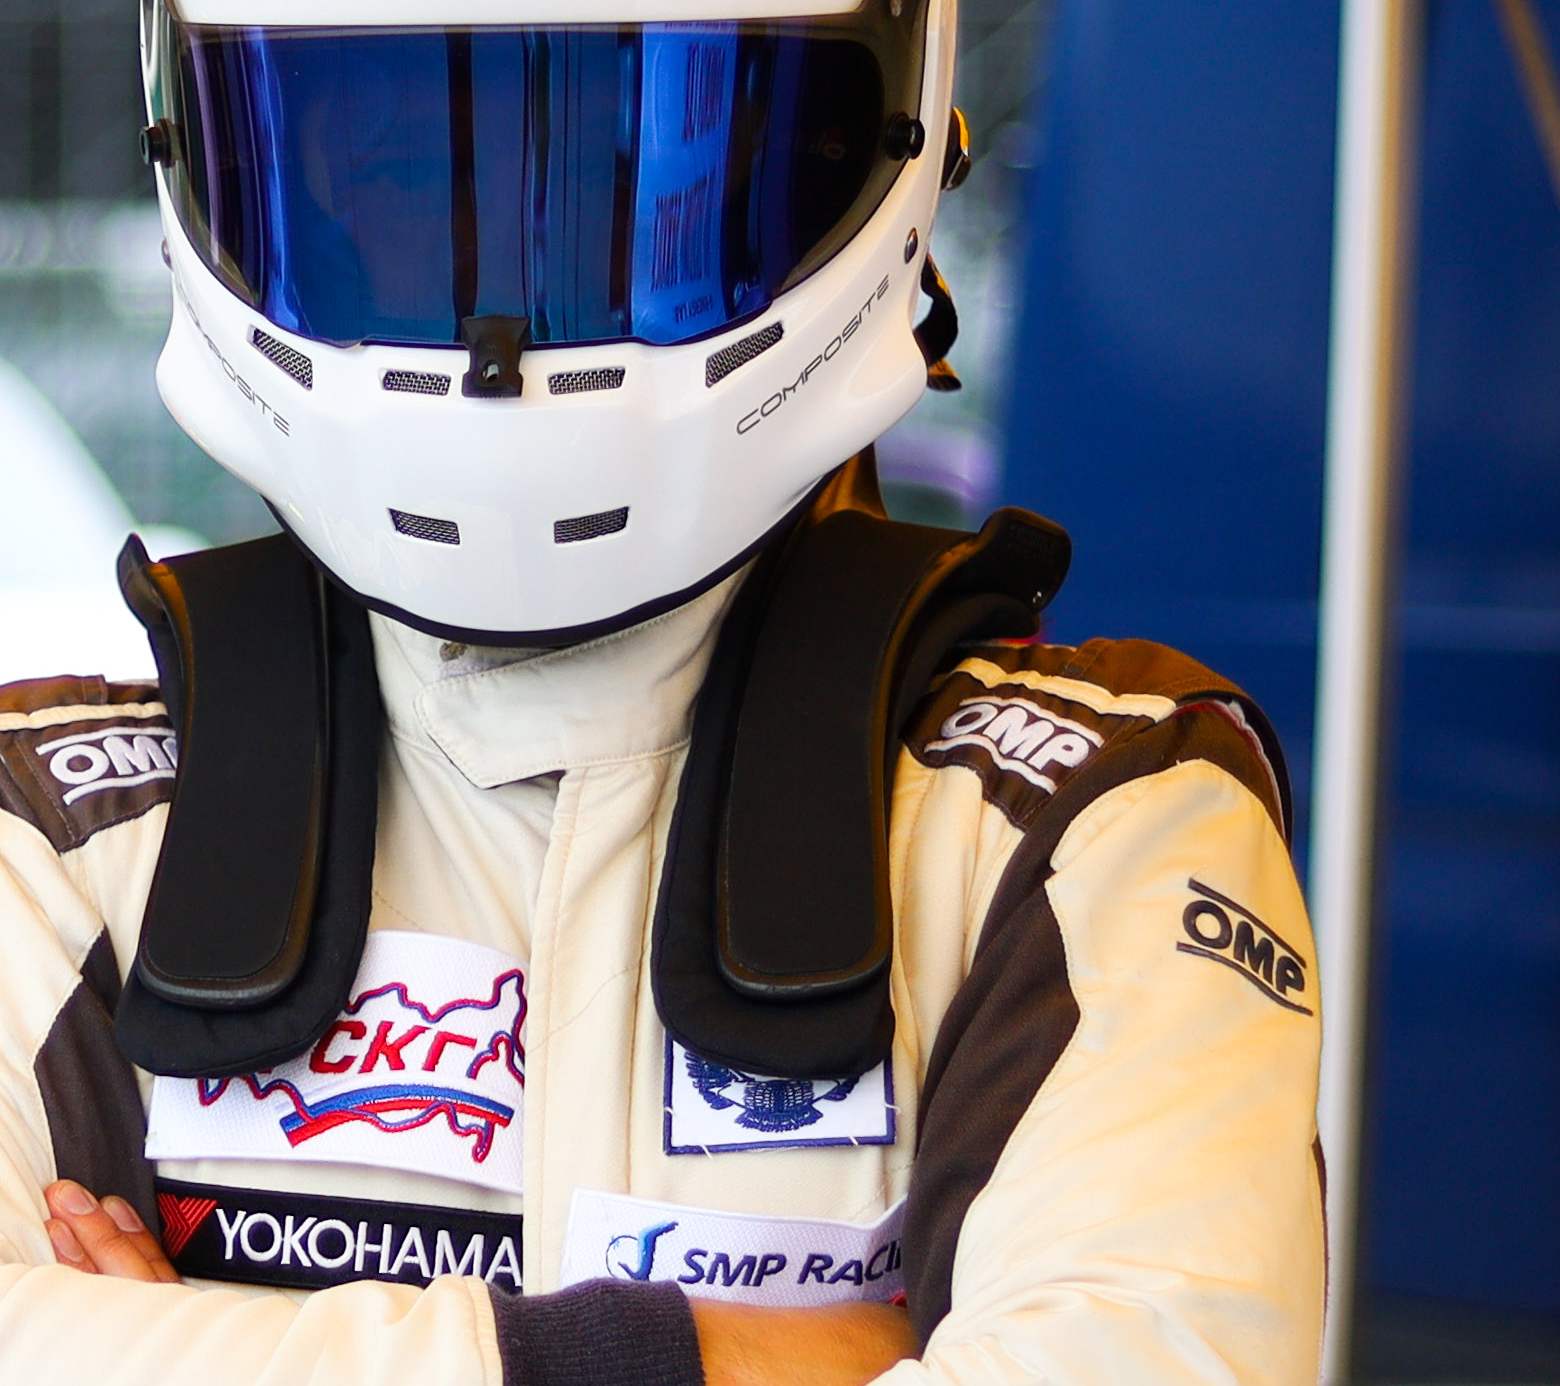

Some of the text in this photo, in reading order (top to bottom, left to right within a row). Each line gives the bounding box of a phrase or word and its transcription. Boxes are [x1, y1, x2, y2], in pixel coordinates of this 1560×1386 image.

[736, 274, 889, 435] COMPOSITE
[49, 735, 178, 786] OM
[940, 701, 1090, 771] OMP
[1182, 899, 1306, 997] OMP
[256, 1019, 478, 1076] СКГ
[215, 1207, 523, 1288] YOKOHAMA
[677, 1247, 789, 1287] SMP
